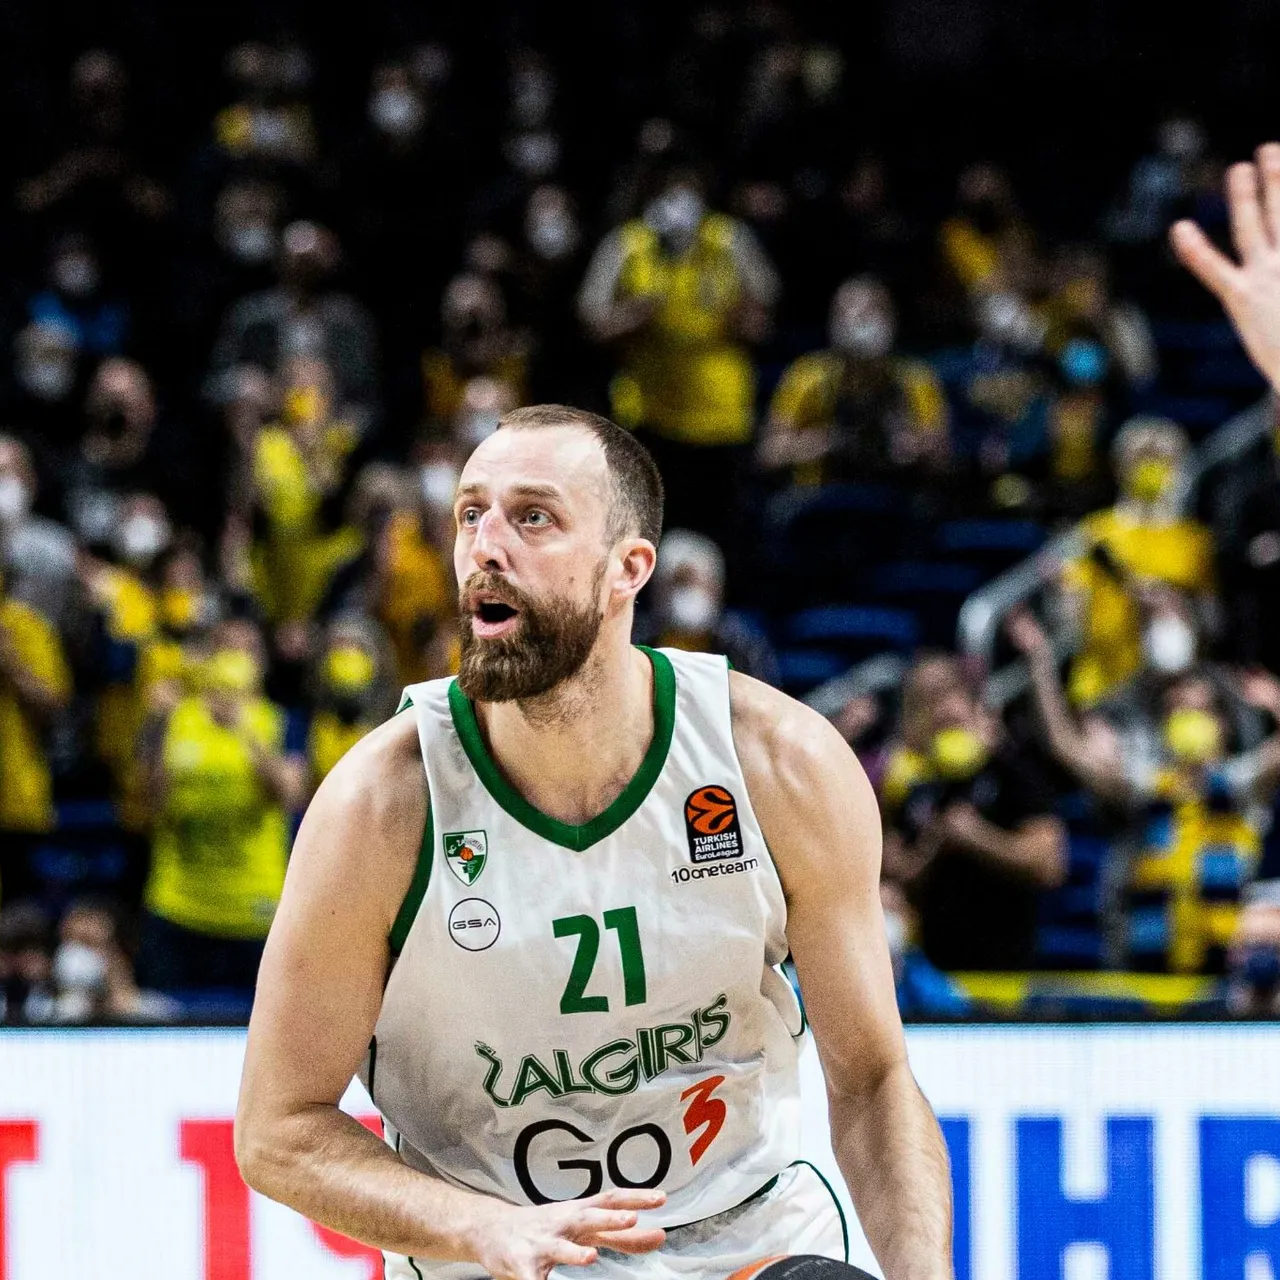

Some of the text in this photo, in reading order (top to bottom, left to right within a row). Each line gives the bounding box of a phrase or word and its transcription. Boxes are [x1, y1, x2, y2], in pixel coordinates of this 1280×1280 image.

[693, 832, 737, 845] TURKISH
[695, 840, 738, 854] AIRLINES
[452, 917, 497, 930] GSA
[552, 906, 647, 1014] 21
